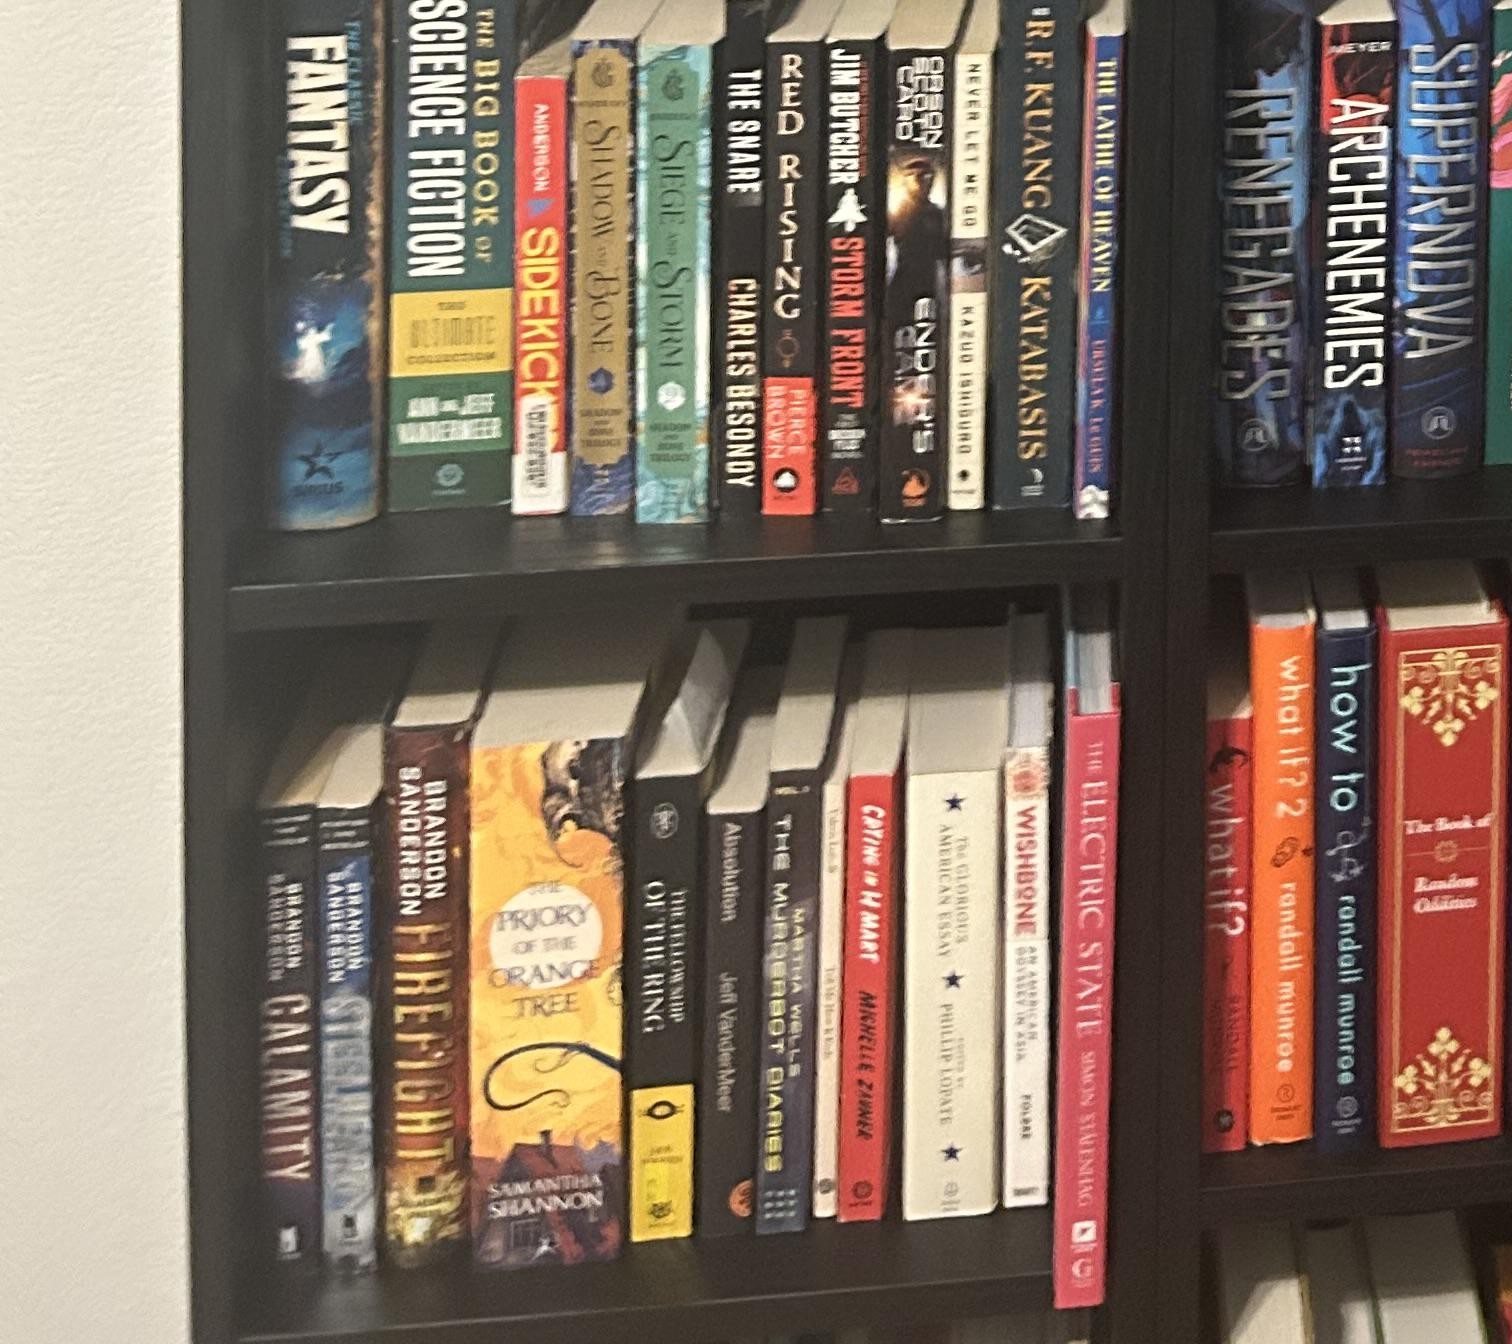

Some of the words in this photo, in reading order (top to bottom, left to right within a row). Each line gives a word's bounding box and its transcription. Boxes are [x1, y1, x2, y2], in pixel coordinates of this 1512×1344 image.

[476, 10, 495, 47] THE
[831, 48, 859, 86] JIM
[1026, 20, 1053, 73] R.F.
[475, 59, 499, 116] BIG
[729, 70, 758, 110] THE
[1098, 57, 1117, 97] THE
[286, 35, 349, 233] FANTASY
[727, 120, 758, 192] SNARE
[829, 92, 860, 184] BUTCHER
[1024, 83, 1052, 208] KUANG
[1094, 104, 1116, 169] LATHE
[407, 150, 467, 277] FICTION
[474, 130, 499, 227] BOOK
[1094, 176, 1114, 203] OF
[1405, 43, 1479, 359] SUPERNOVA
[475, 237, 493, 262] OF
[831, 237, 860, 317] STORM
[1091, 211, 1113, 292] HEAVEN
[1325, 98, 1386, 388] ARCHENEMIES
[727, 279, 756, 377] CHARLES
[830, 329, 859, 407] FRONT
[1019, 276, 1051, 459] KATABASIS
[726, 386, 755, 487] BESONDY
[1277, 656, 1304, 735] what
[1330, 663, 1371, 752] how
[1087, 742, 1104, 774] THE
[1277, 747, 1303, 787] if?
[1331, 772, 1365, 812] to
[399, 768, 421, 915] SANDERSON
[425, 780, 446, 899] BRANDON
[861, 805, 886, 865] CRYING
[1276, 799, 1302, 817] 2
[721, 822, 739, 921] Absolution
[1015, 806, 1038, 935] WISHBONE
[1078, 781, 1107, 928] ELECTRIC
[858, 912, 880, 962] MART
[860, 890, 882, 906] H
[1336, 895, 1362, 983] randall
[719, 973, 736, 1003] Jeff
[1076, 942, 1103, 1038] STATE
[393, 924, 455, 1162] FIREFIGHT
[717, 1009, 735, 1111] VanderMeer
[1336, 994, 1358, 1084] munroe
